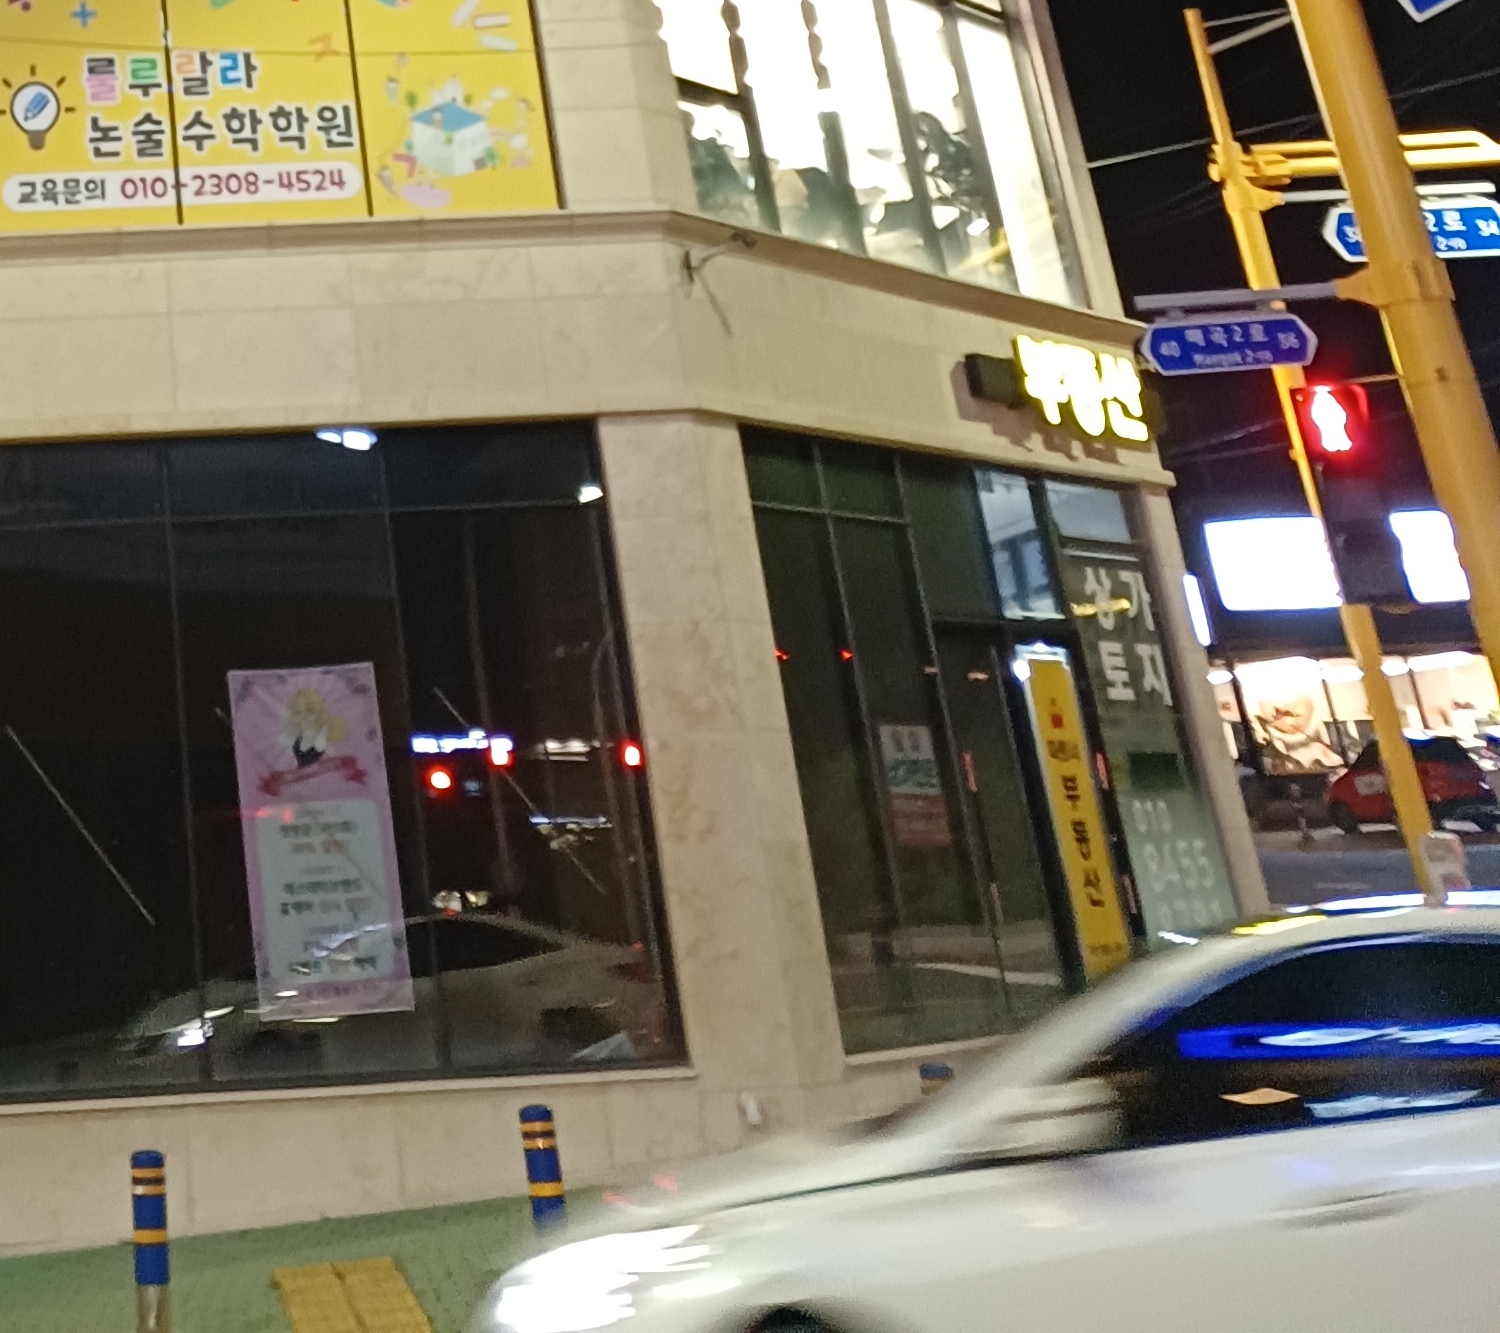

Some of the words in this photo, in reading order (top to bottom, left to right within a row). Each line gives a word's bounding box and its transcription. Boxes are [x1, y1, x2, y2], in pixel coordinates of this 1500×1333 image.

[85, 50, 258, 103] 룰루랄라
[88, 104, 355, 159] 논술수학학원
[17, 178, 107, 205] 교육문의
[120, 169, 347, 200] 010-2308-4524
